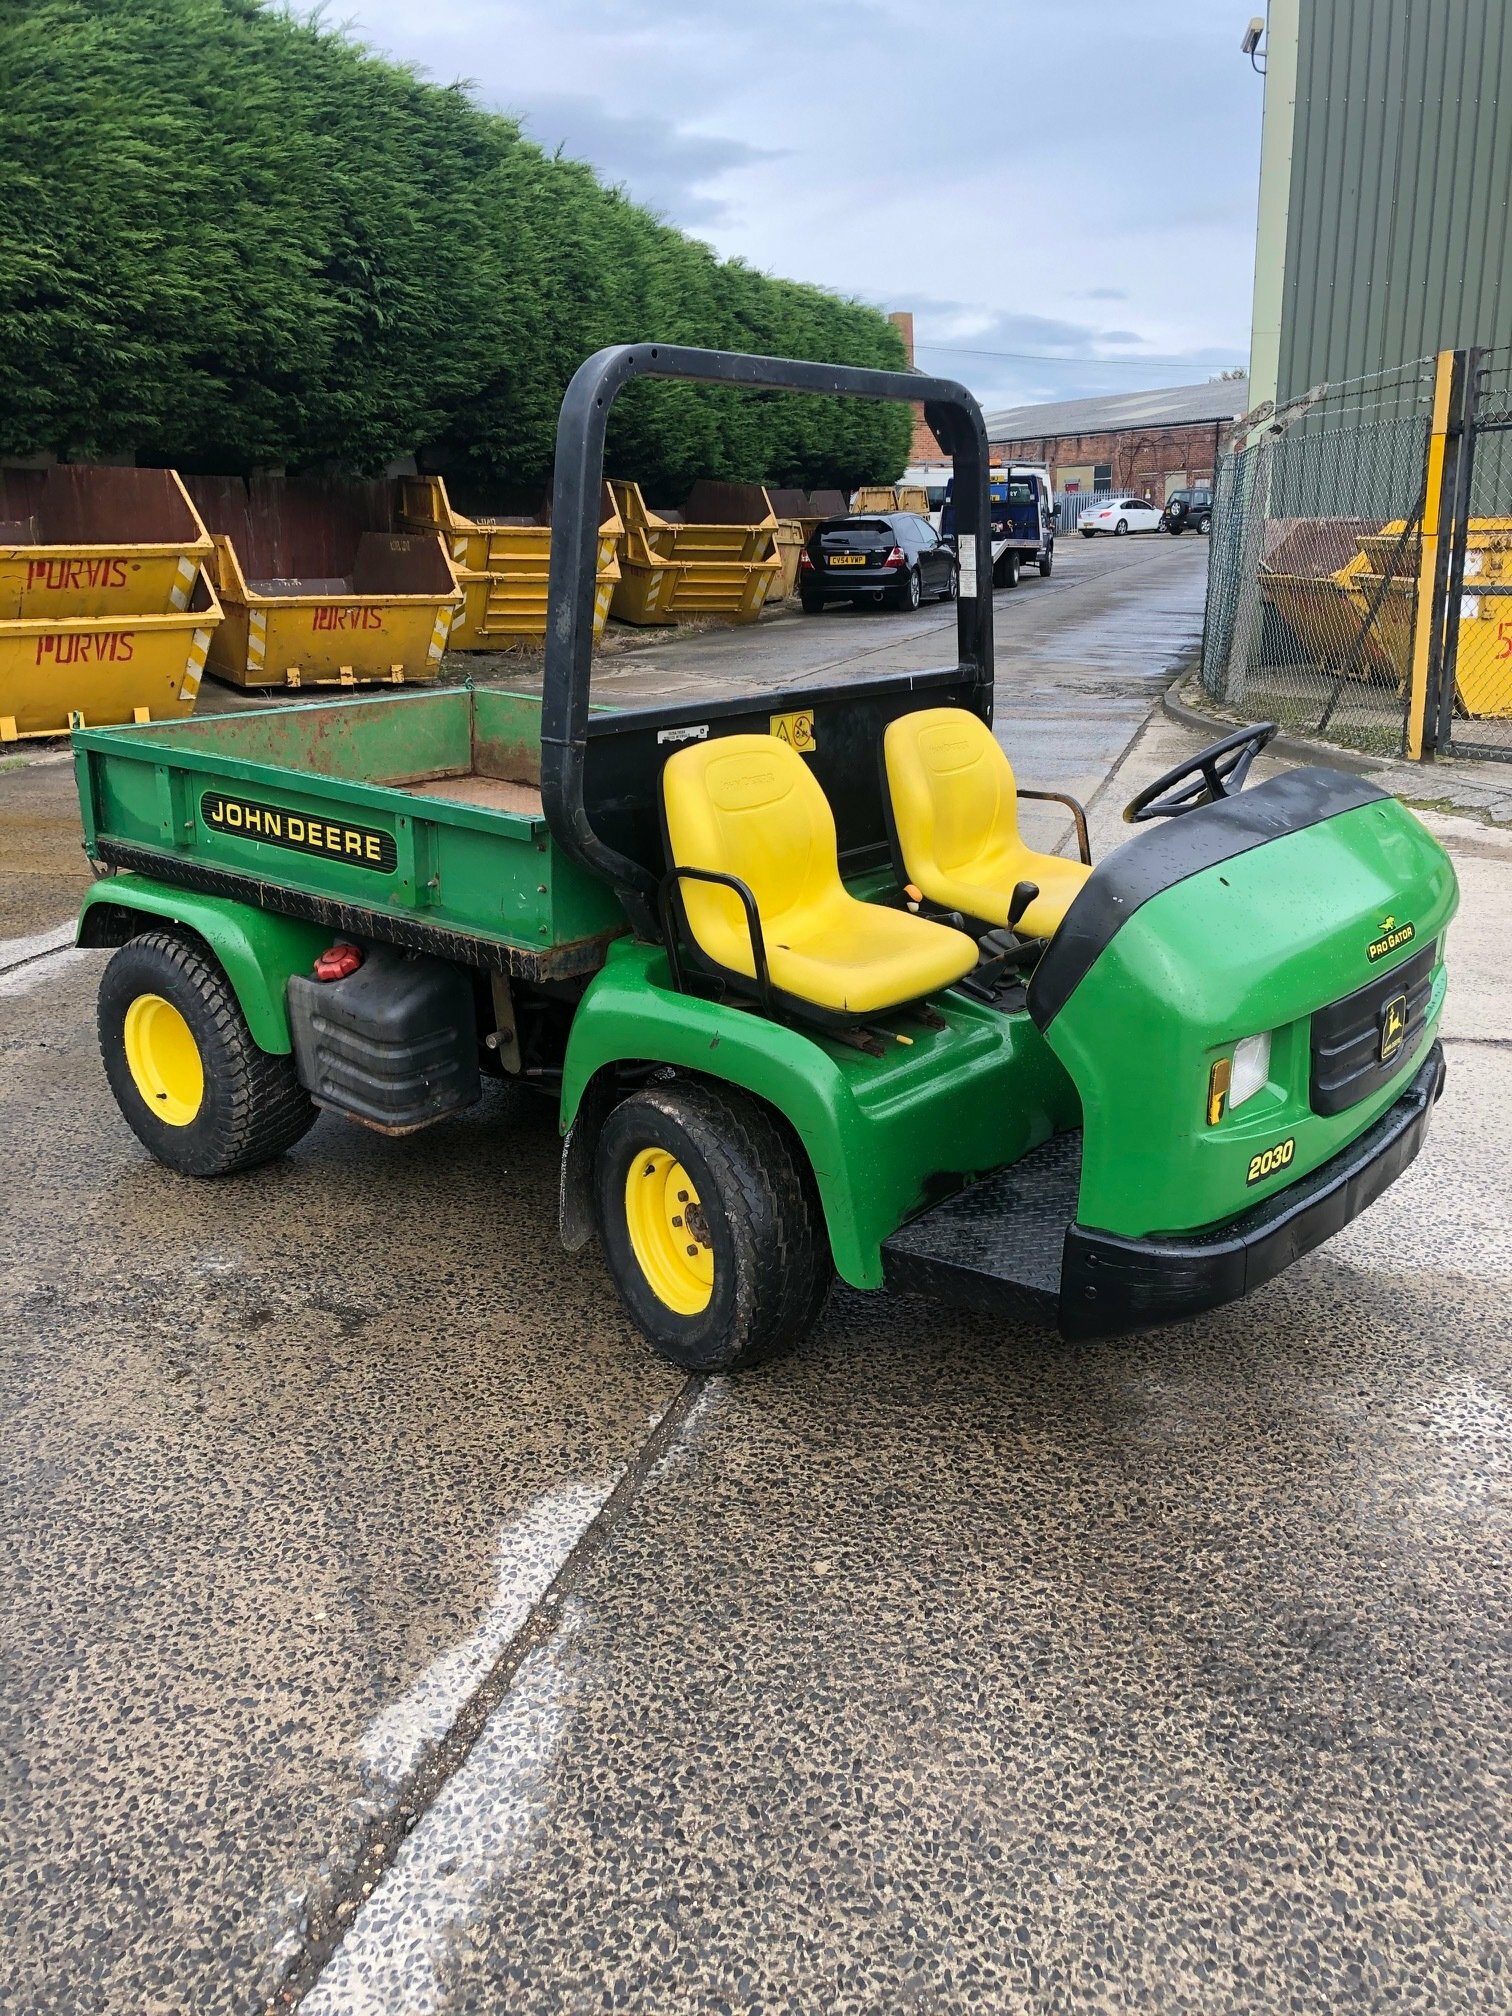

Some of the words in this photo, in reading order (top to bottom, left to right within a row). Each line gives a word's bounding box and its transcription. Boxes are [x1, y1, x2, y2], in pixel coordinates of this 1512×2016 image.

[27, 559, 128, 590] PURVIS
[36, 632, 135, 666] PURVIS
[211, 801, 282, 837] JOHN
[287, 817, 382, 861] DEERE
[1369, 940, 1388, 959] PRO
[1387, 926, 1413, 948] GATOR
[1247, 1139, 1294, 1181] 2030
